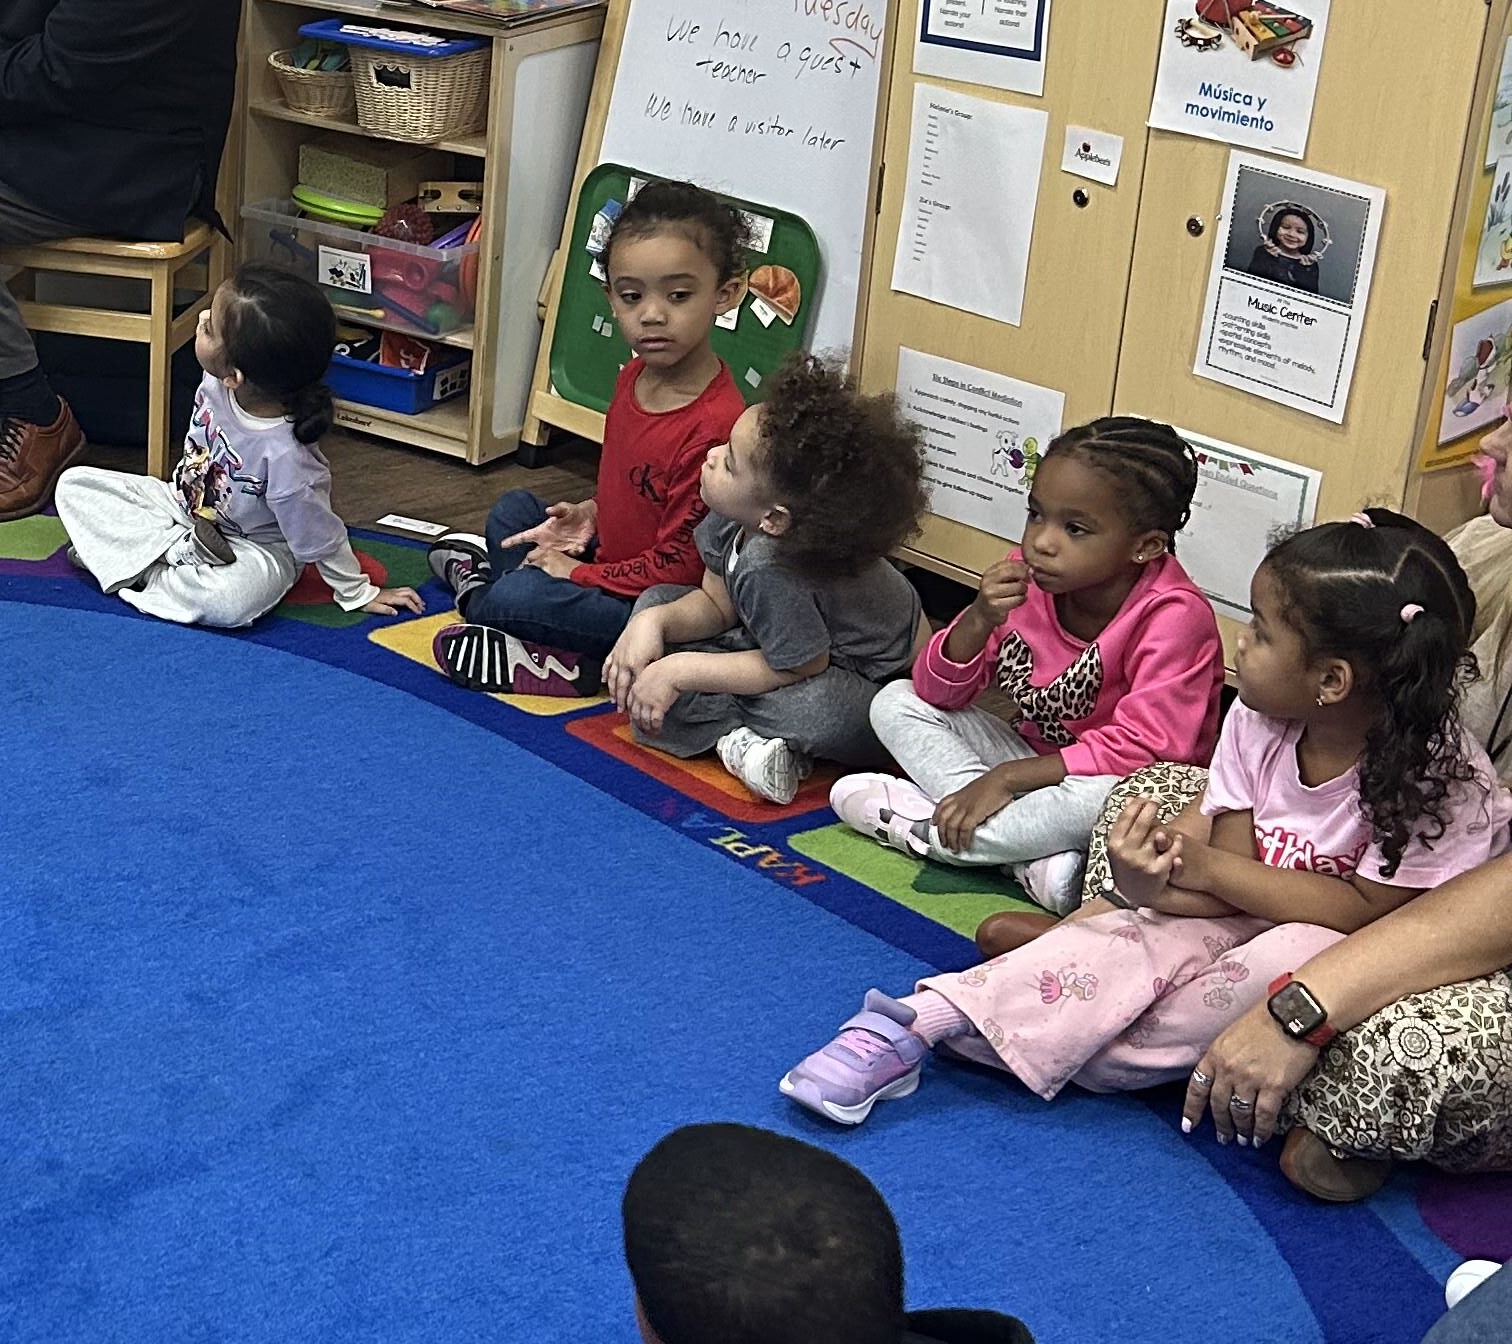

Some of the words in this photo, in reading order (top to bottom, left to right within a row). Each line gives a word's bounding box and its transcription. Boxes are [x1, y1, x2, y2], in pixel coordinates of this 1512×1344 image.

[666, 16, 700, 44] We
[713, 18, 759, 53] have
[776, 42, 791, 62] a
[696, 58, 767, 86] teacher
[1199, 82, 1253, 107] Música
[1257, 95, 1268, 111] y
[644, 92, 671, 121] We
[681, 102, 716, 130] have
[727, 115, 737, 132] a
[745, 114, 794, 137] visitor
[802, 126, 846, 151] later
[1185, 102, 1274, 133] movimiento
[1248, 296, 1278, 315] Music
[1280, 306, 1318, 326] Center
